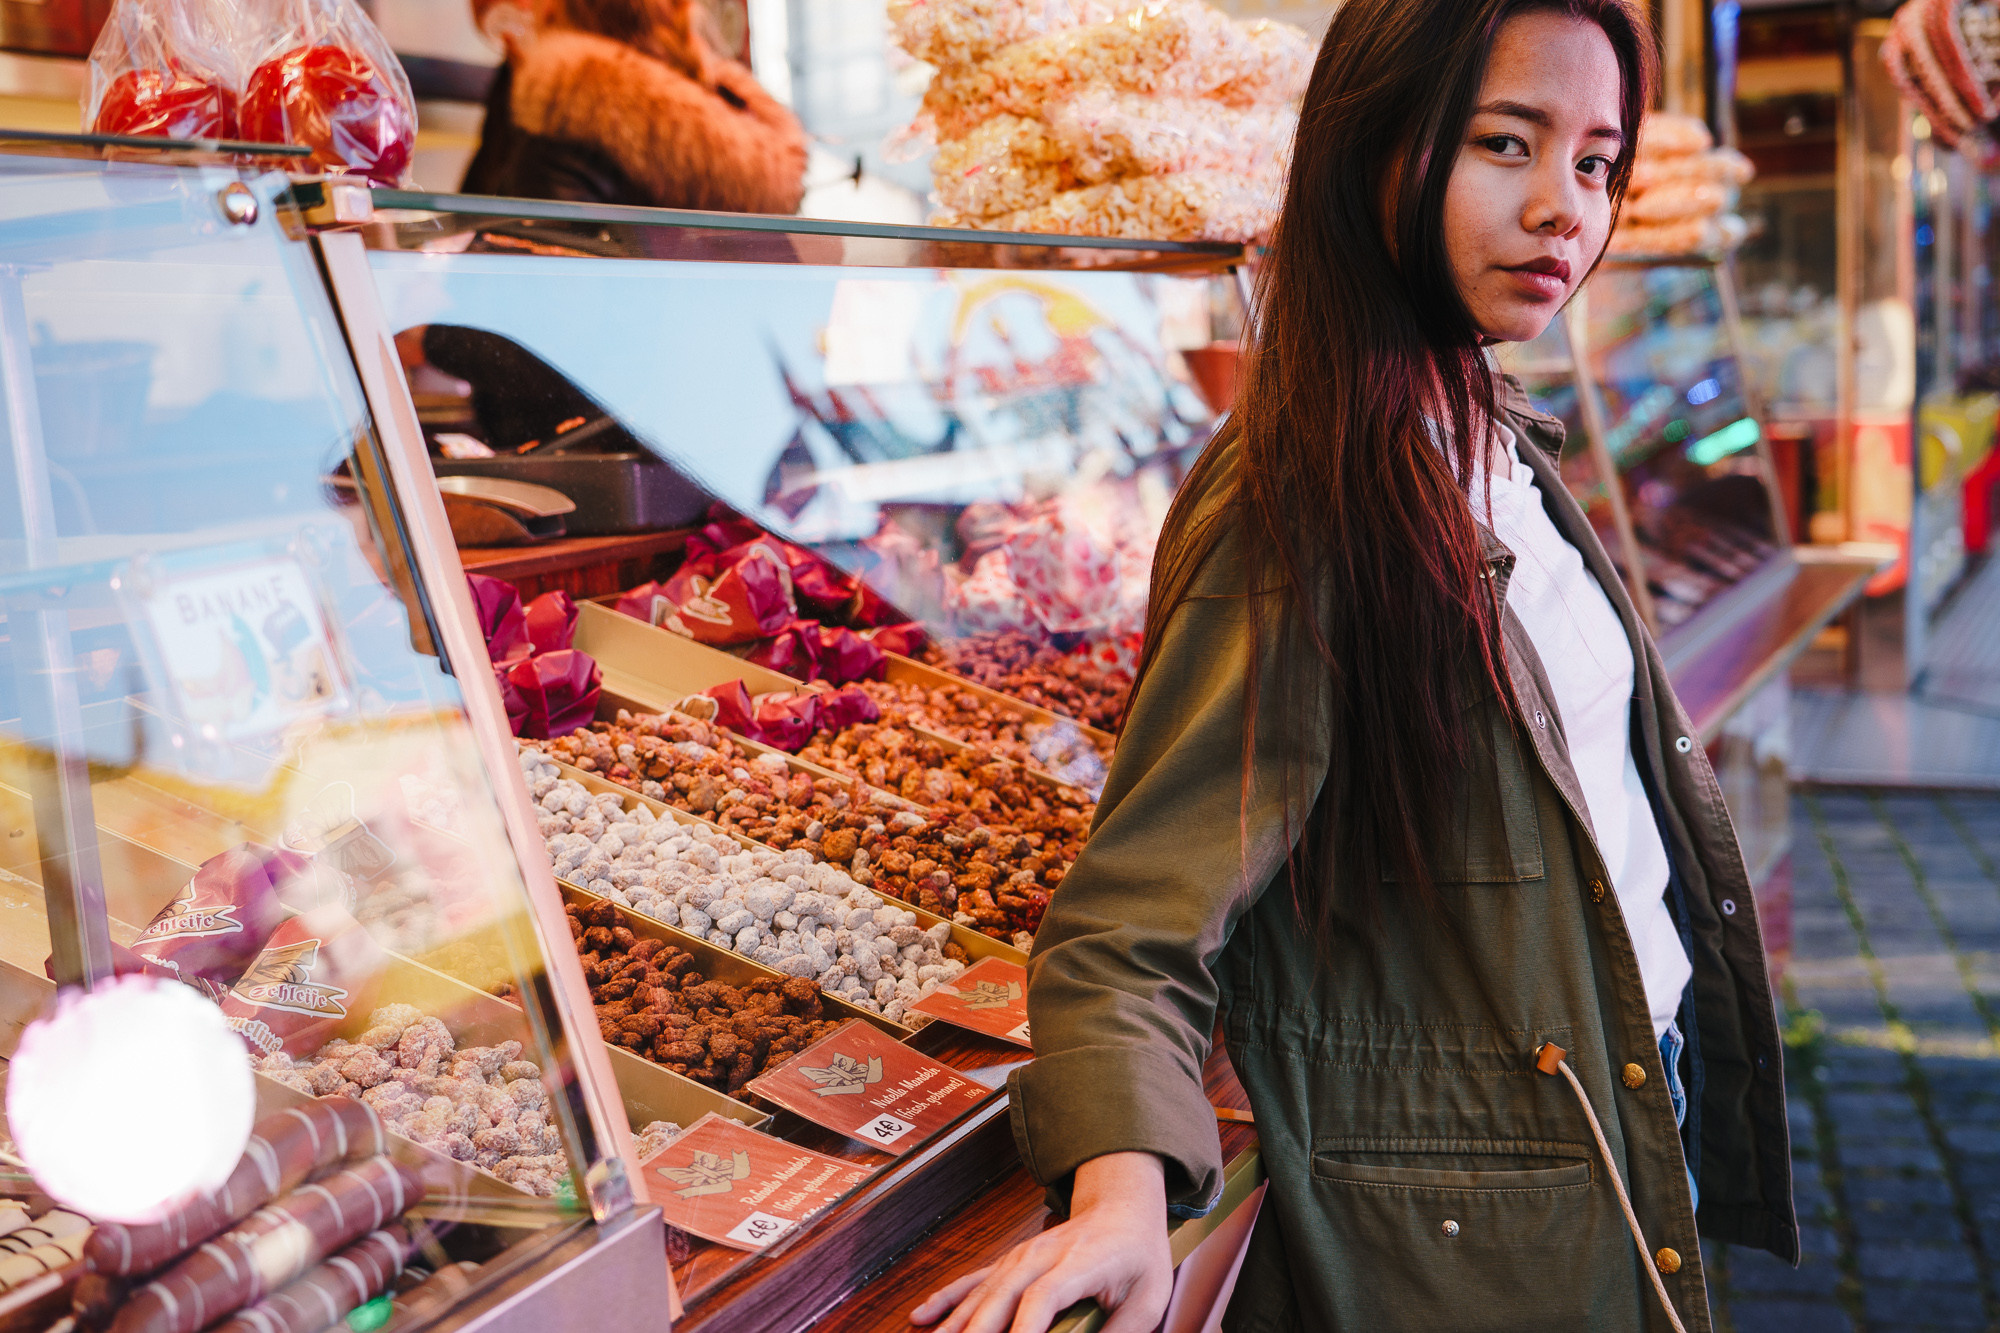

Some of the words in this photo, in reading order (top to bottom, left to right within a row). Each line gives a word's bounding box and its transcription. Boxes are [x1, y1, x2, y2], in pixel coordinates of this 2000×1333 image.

[176, 574, 285, 626] BANANE
[249, 984, 327, 1008] Schleife
[870, 1087, 908, 1109] Nutella
[898, 1066, 941, 1090] Mandeln
[894, 1099, 930, 1120] (frisch
[926, 1076, 966, 1105] gebrannt)
[963, 1088, 986, 1099] 100g
[874, 1120, 902, 1138] 4€
[739, 1179, 783, 1206] Rafaello
[772, 1156, 813, 1182] Mandeln
[772, 1191, 808, 1212] (frisch
[803, 1163, 842, 1193] gebrannt)
[747, 1219, 779, 1239] 4€
